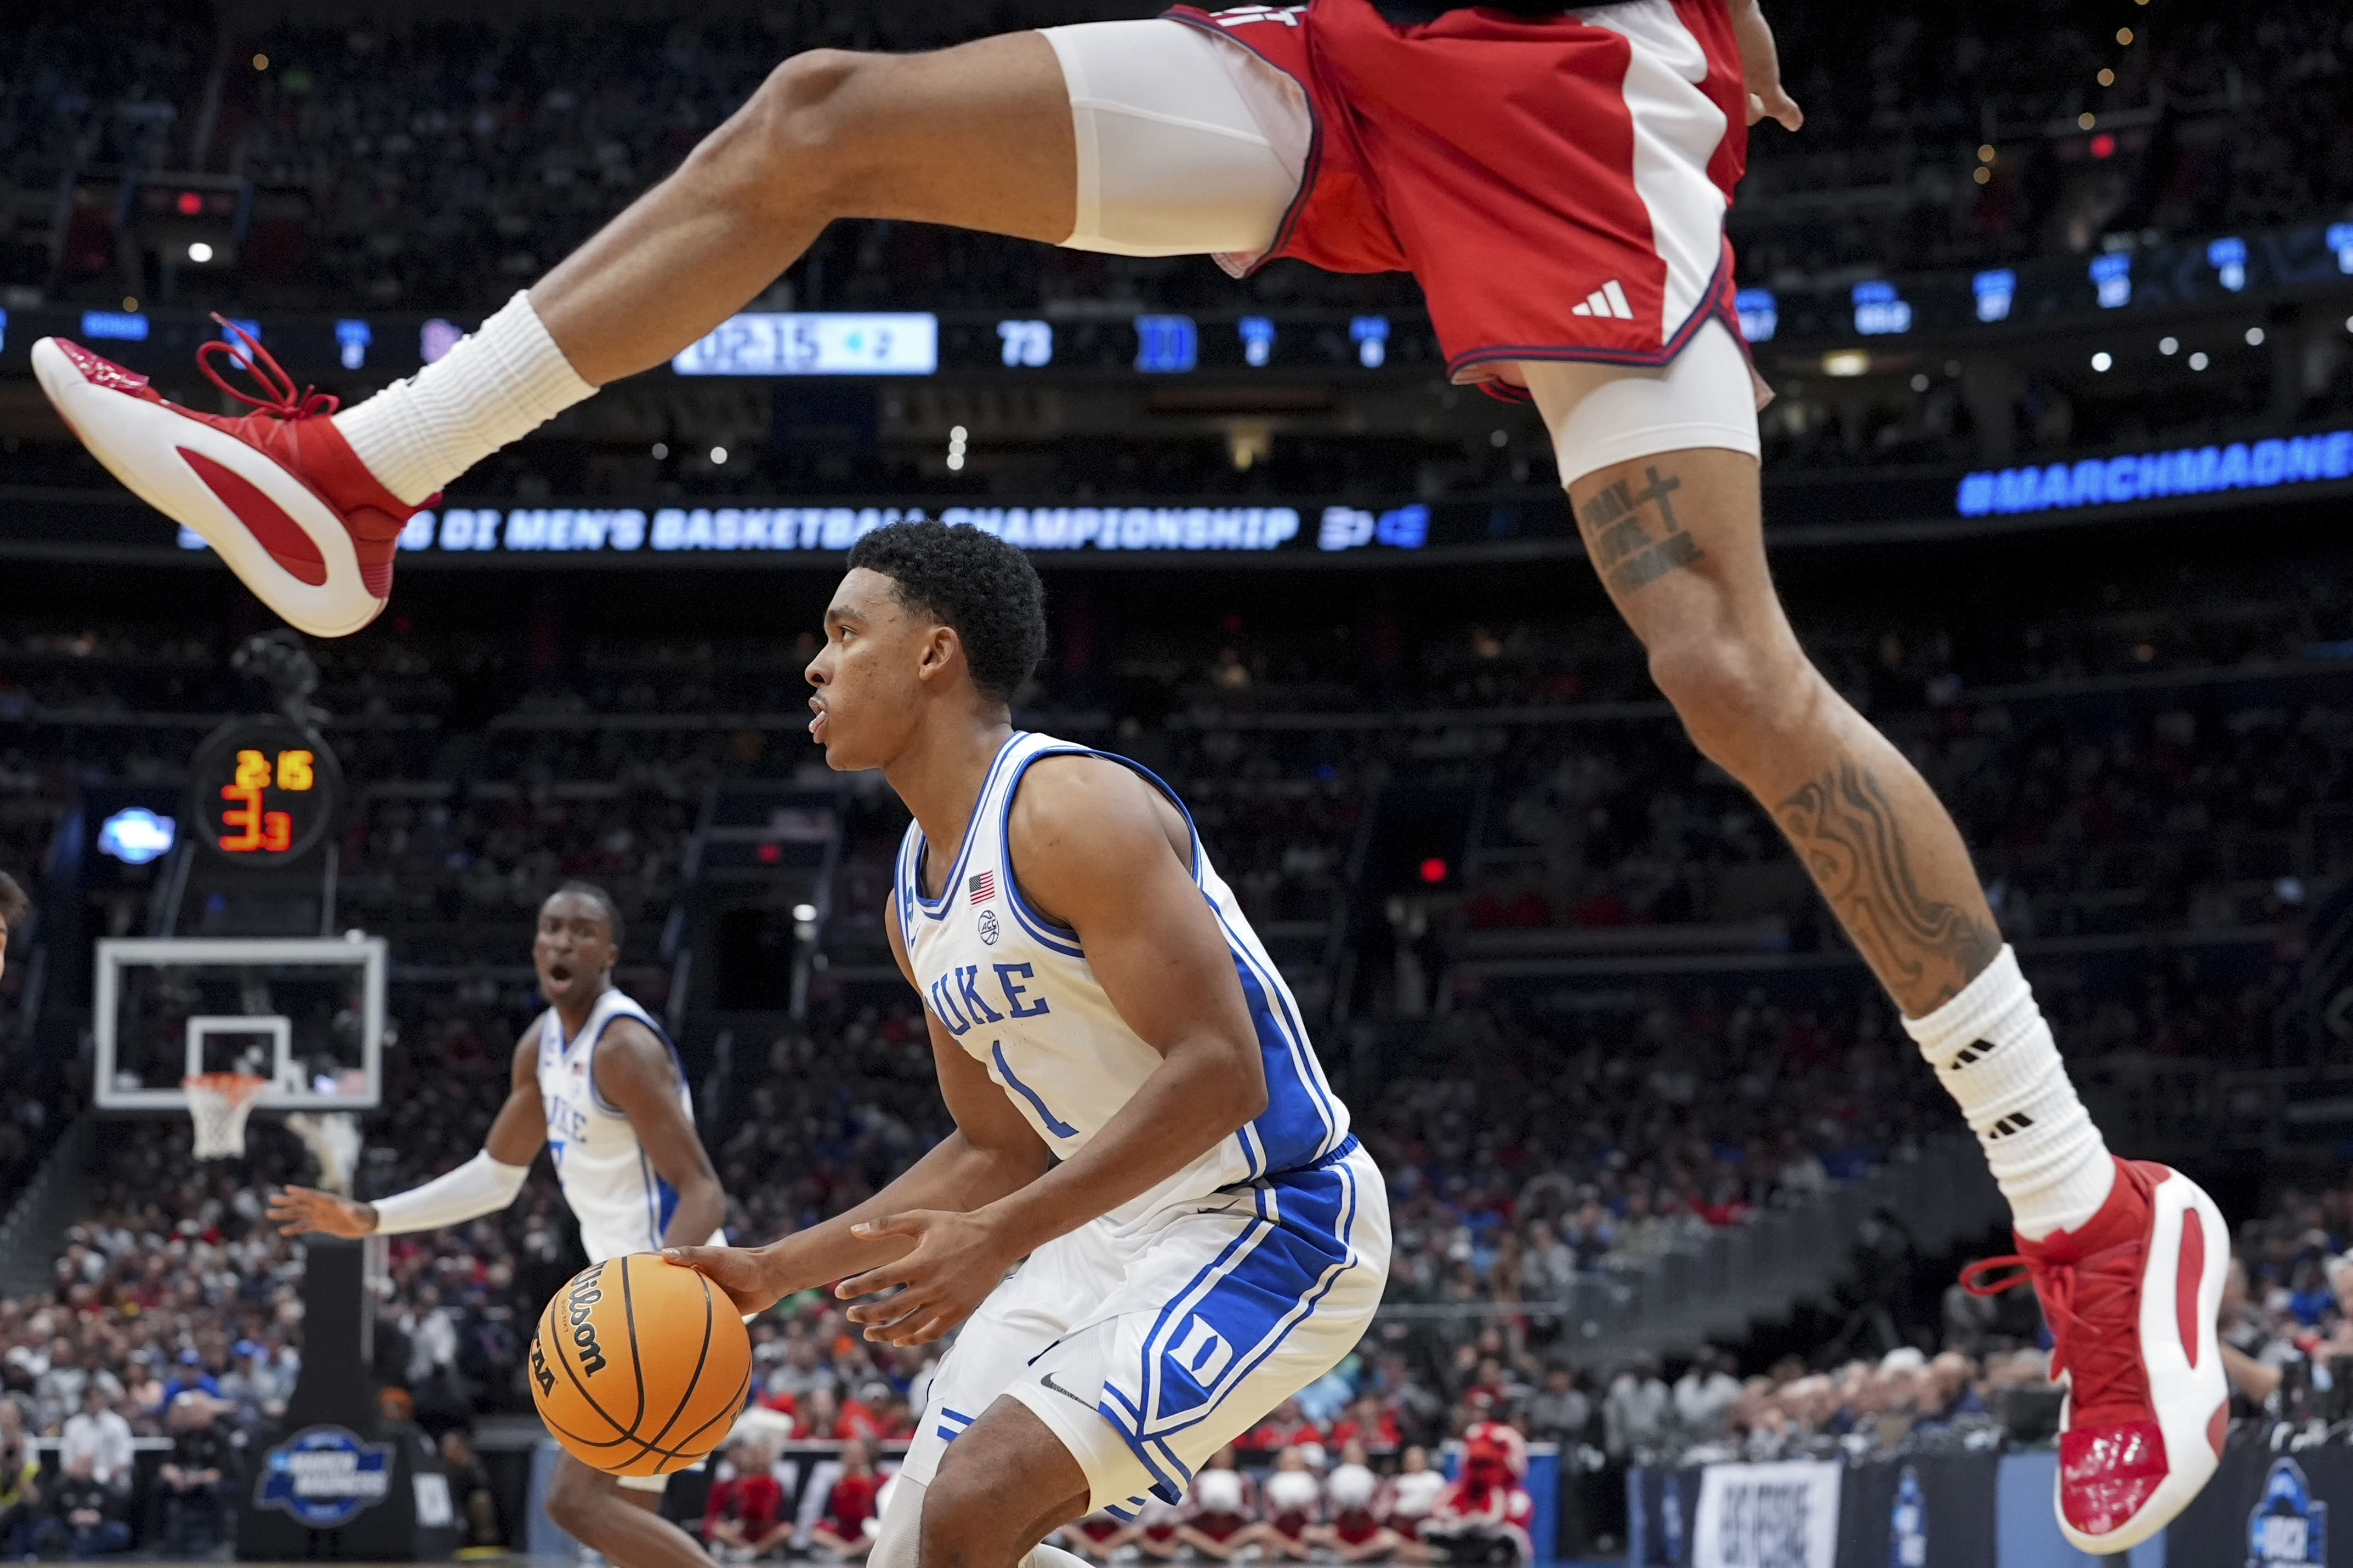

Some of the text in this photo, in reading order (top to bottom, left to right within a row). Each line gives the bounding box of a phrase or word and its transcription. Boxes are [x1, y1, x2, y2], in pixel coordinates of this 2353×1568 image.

[981, 919, 997, 932] ACC
[925, 962, 1049, 1035] UKE
[993, 1040, 1079, 1138] 1
